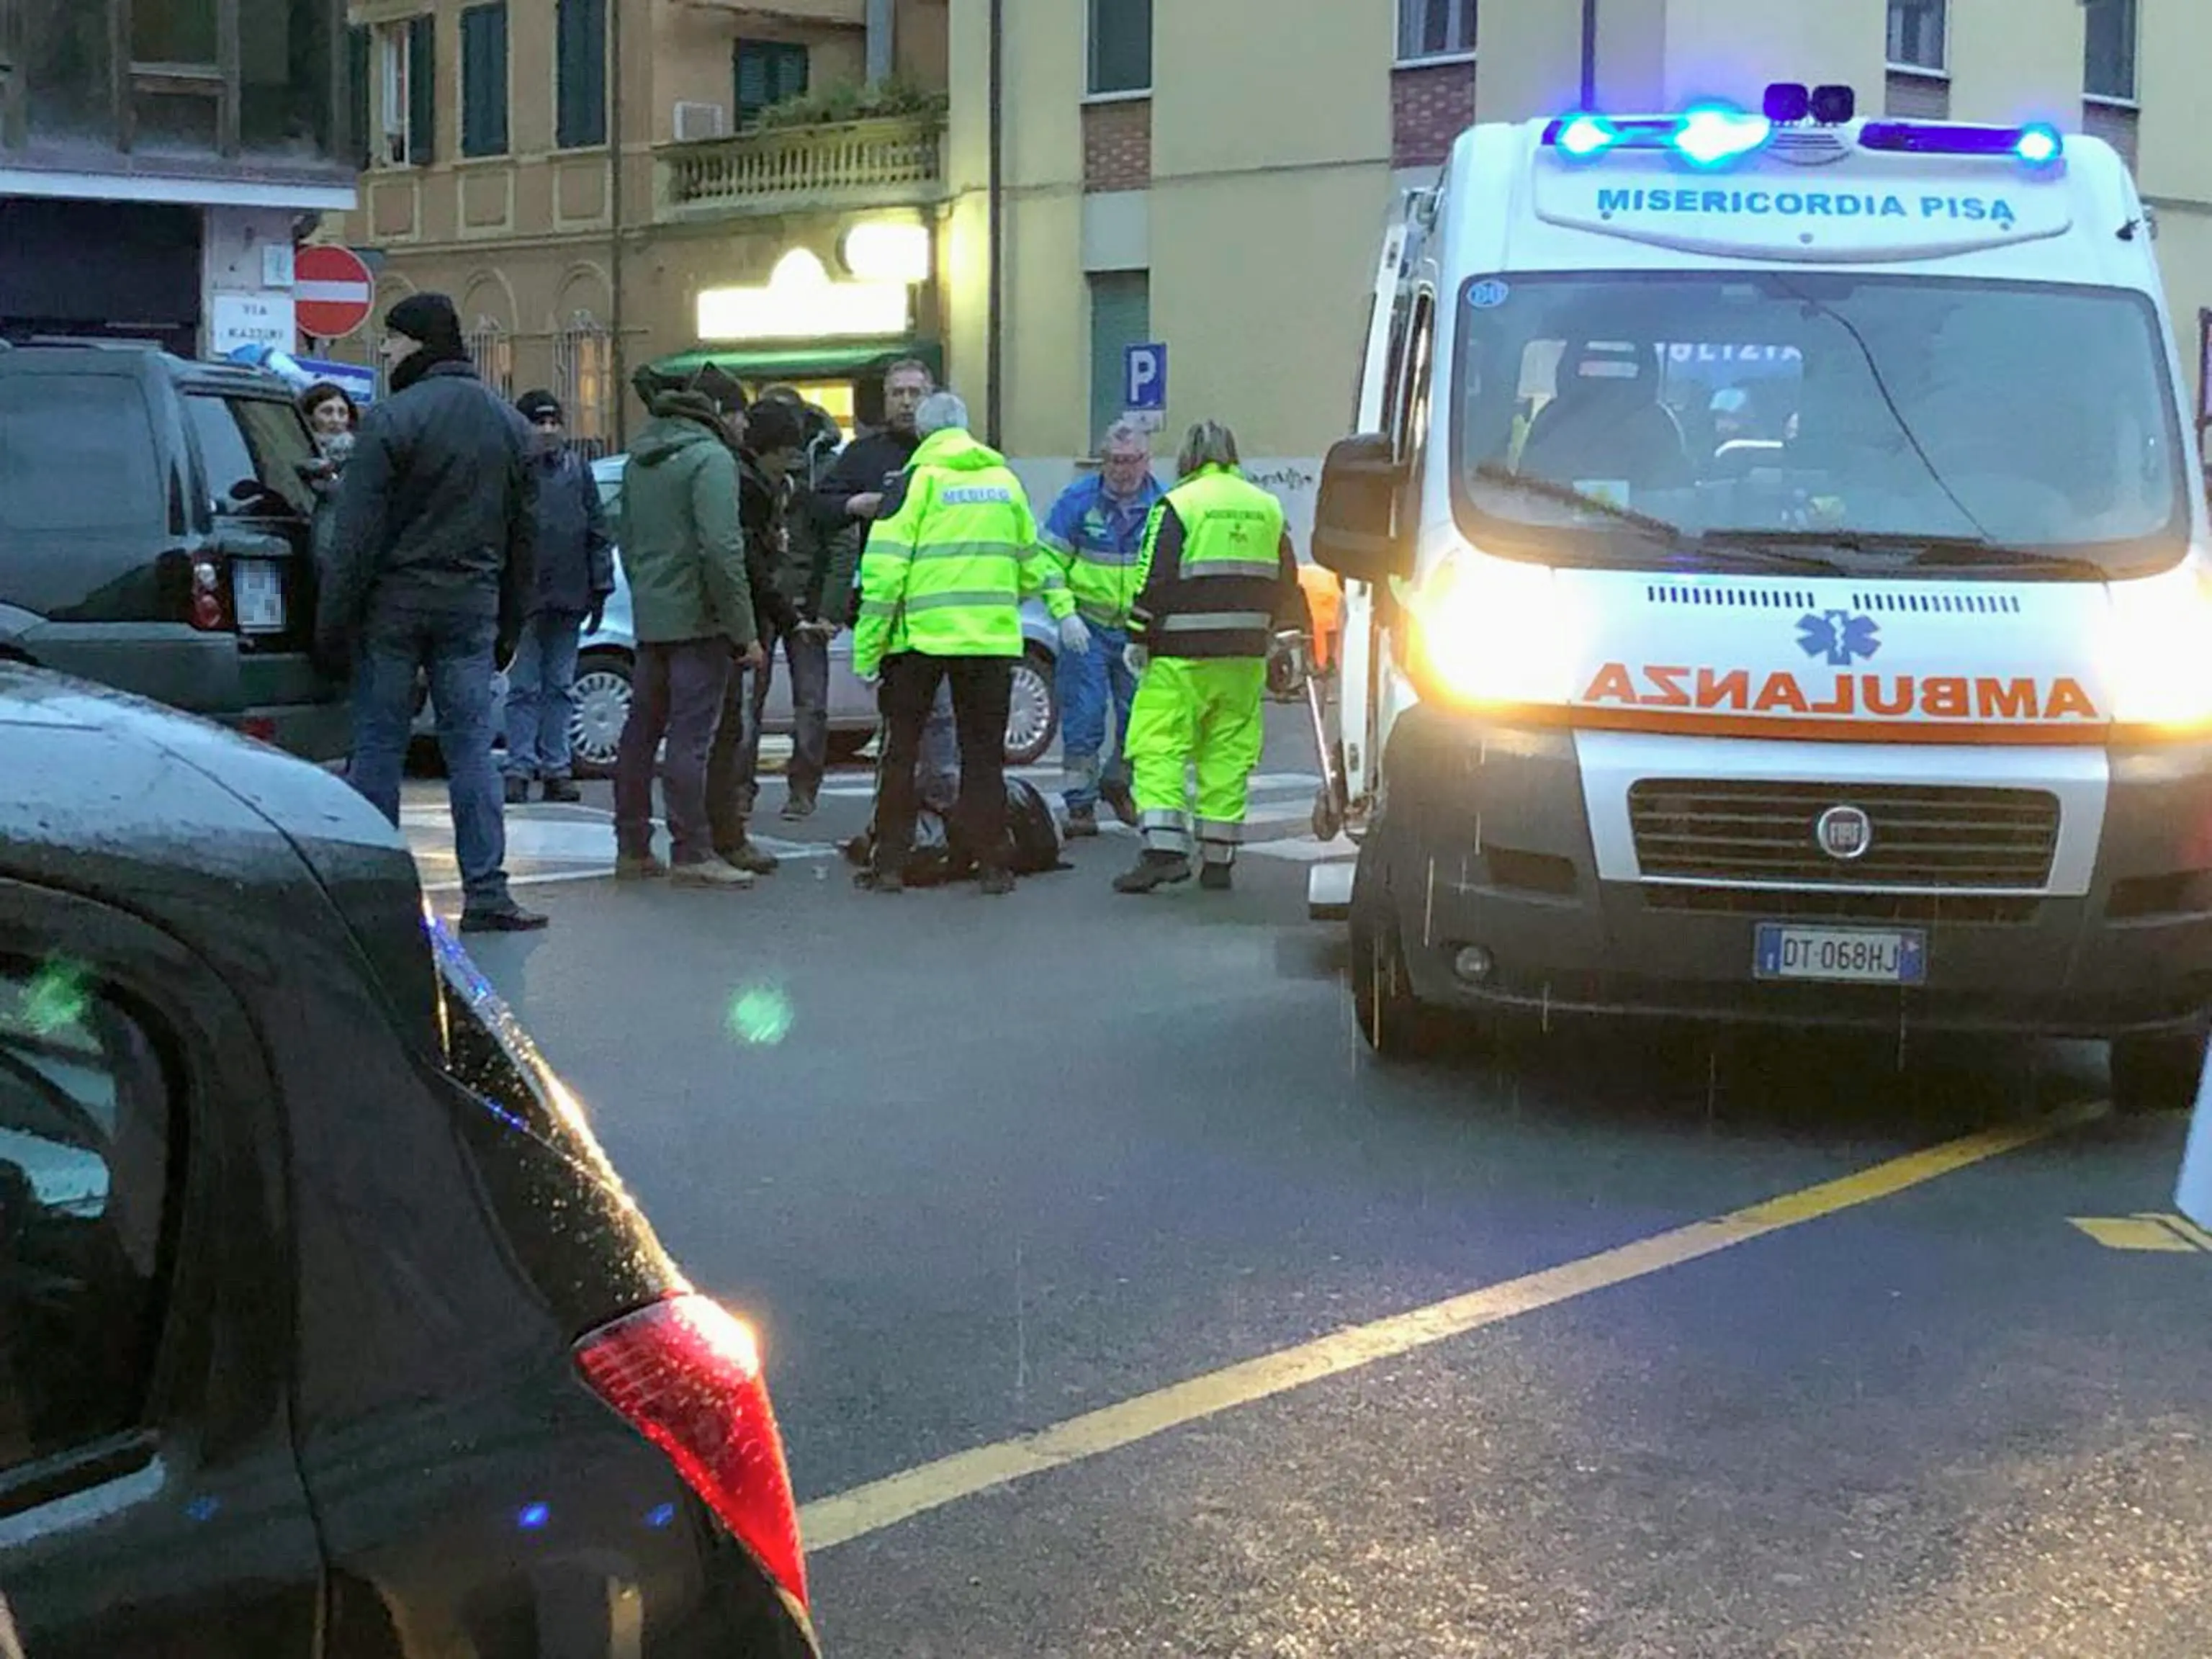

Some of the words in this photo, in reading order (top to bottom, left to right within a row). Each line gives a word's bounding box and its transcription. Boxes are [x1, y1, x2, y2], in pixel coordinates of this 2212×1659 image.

[1597, 189, 1907, 217] MISERICORDIA
[1920, 196, 2015, 222] PISA
[1130, 349, 1157, 402] P
